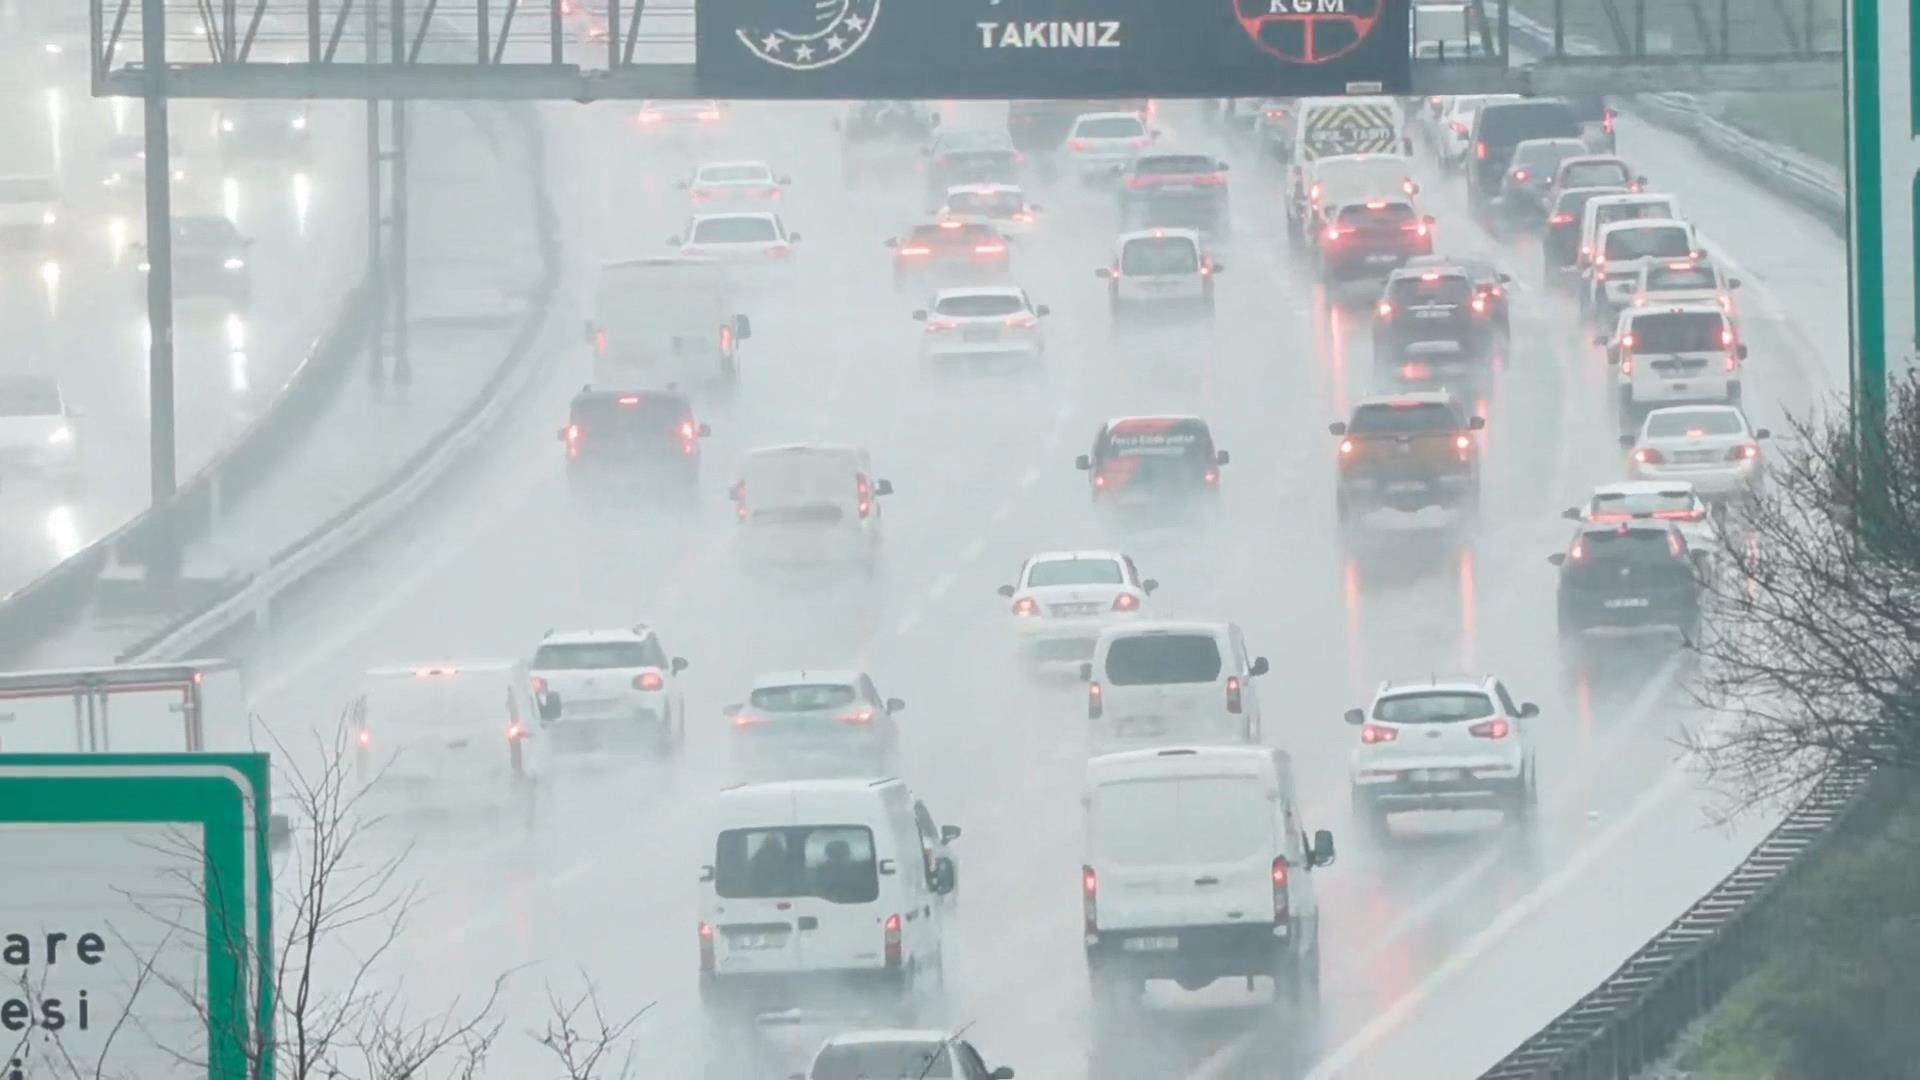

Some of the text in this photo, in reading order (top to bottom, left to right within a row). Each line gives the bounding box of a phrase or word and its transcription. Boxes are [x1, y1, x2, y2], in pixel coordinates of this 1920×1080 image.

[1269, 0, 1345, 13] KGM
[976, 22, 1121, 48] TAKINIZ
[3, 932, 105, 965] are
[1, 989, 88, 1031] esi
